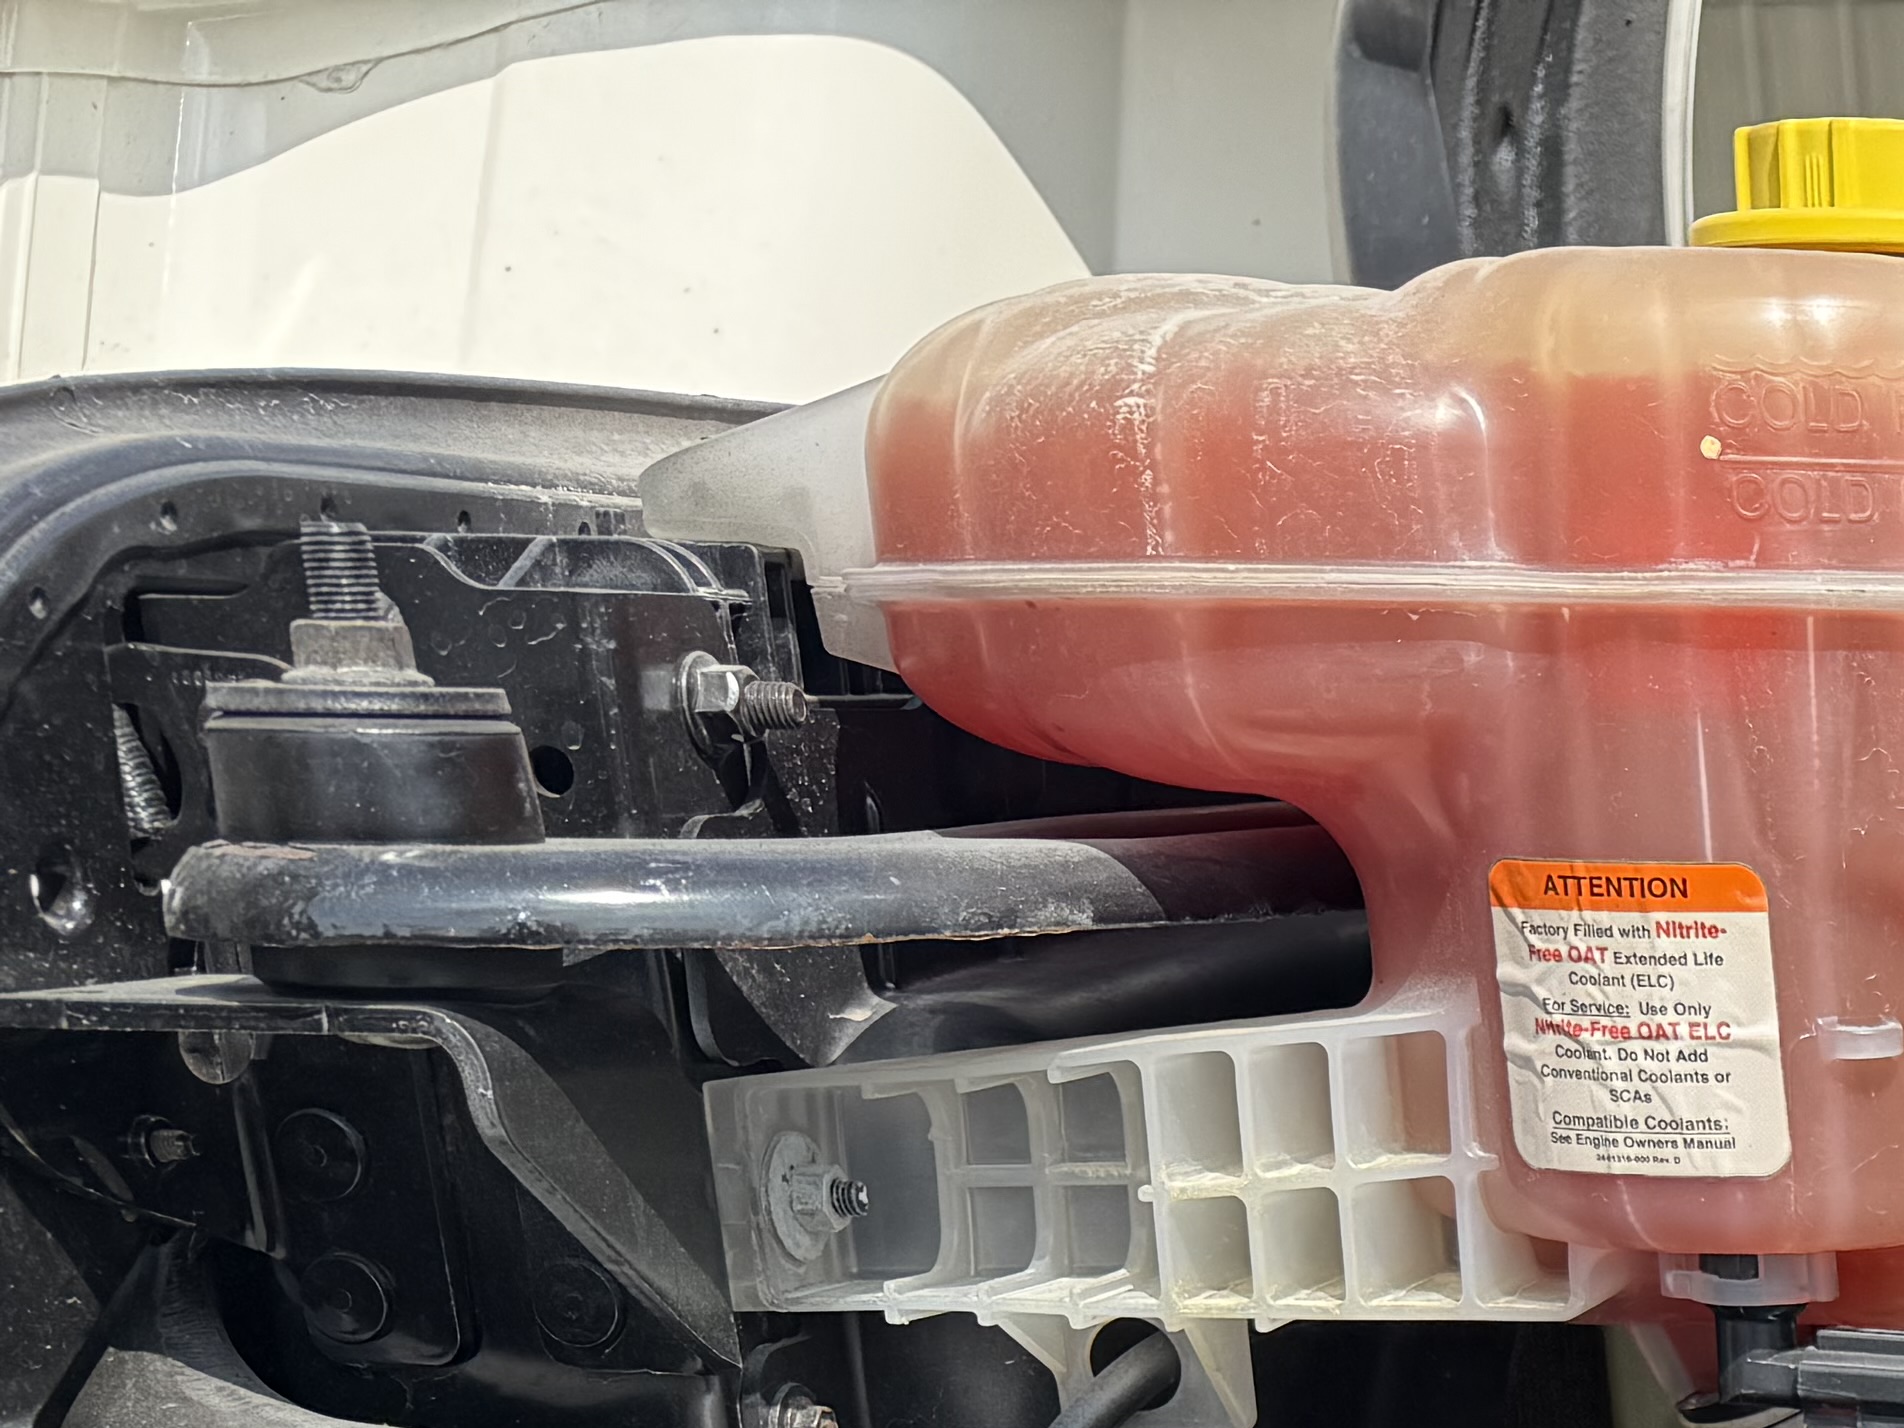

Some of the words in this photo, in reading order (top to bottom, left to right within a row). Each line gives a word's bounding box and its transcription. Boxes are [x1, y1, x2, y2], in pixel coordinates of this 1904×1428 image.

[1711, 380, 1863, 432] COLD
[1730, 472, 1875, 522] COLD
[1543, 874, 1688, 899] ATTENTION
[1521, 920, 1568, 941] Factory
[1573, 922, 1613, 939] Filled
[1618, 924, 1651, 940] with
[1528, 946, 1563, 963] Free
[1568, 947, 1608, 966] OAT
[1613, 951, 1688, 967] Extended
[1693, 951, 1724, 967] Life
[1569, 971, 1626, 988] Coolant
[1630, 973, 1675, 991] (ELC)
[1542, 998, 1566, 1013] For
[1570, 999, 1630, 1015] Service:
[1639, 1001, 1668, 1016] Use
[1673, 1002, 1712, 1019] Only
[1637, 1021, 1680, 1041] OAT
[1689, 1021, 1732, 1042] ELC
[1555, 1044, 1613, 1061] Coolant.
[1617, 1047, 1638, 1062] Do
[1643, 1049, 1671, 1063] Not
[1676, 1049, 1709, 1063] Add
[1541, 1064, 1633, 1082] Conventional
[1638, 1068, 1710, 1084] Coolants
[1715, 1071, 1731, 1084] or
[1609, 1088, 1652, 1104] SCAs
[1552, 1110, 1639, 1130] Compatible
[1644, 1115, 1729, 1132] Coolants:
[1551, 1131, 1572, 1145] See
[1576, 1133, 1619, 1149] Engine
[1623, 1136, 1679, 1150] Owners
[1683, 1136, 1736, 1150] Manual
[1673, 1156, 1681, 1164] D
